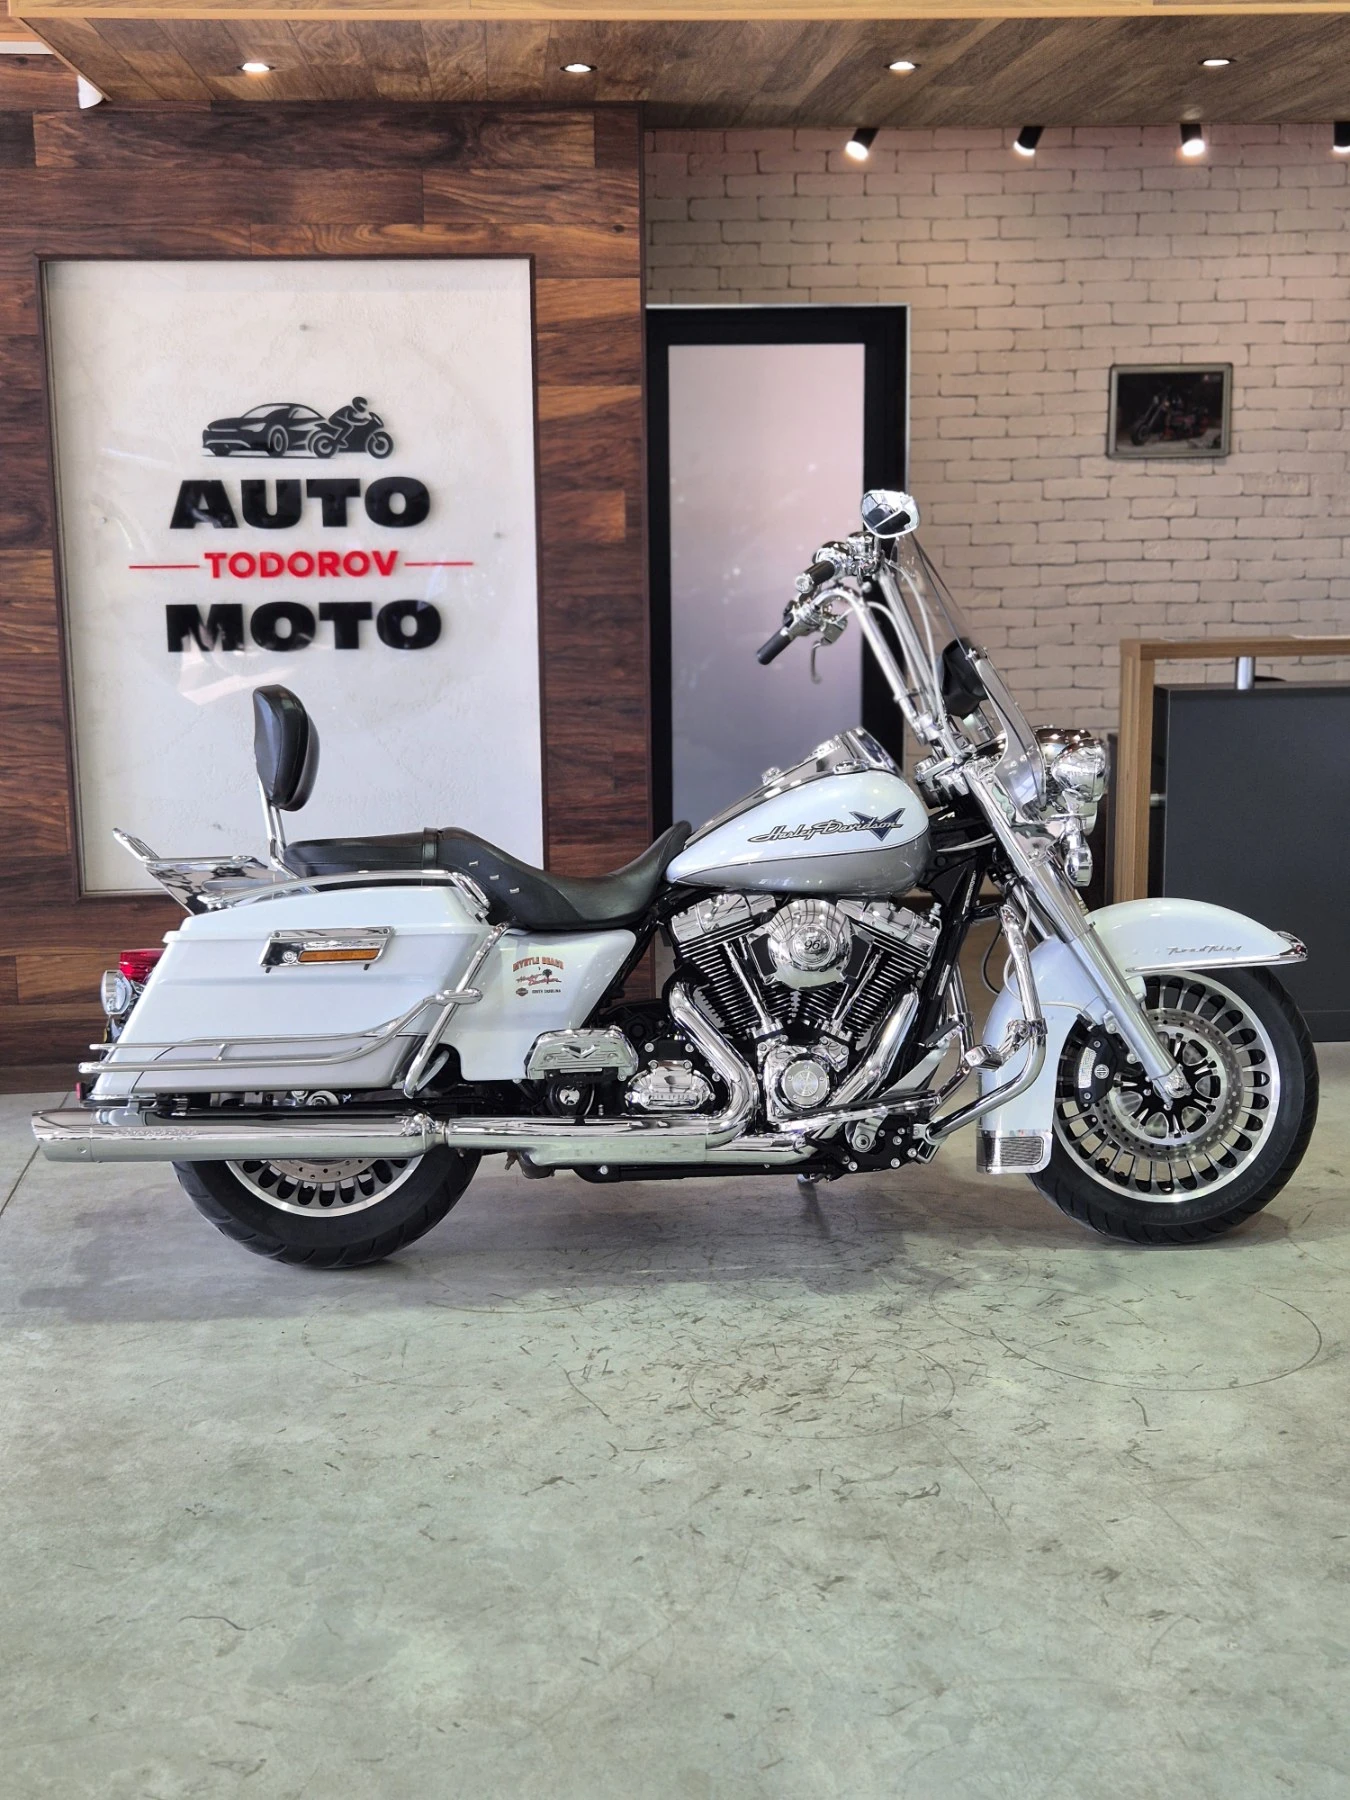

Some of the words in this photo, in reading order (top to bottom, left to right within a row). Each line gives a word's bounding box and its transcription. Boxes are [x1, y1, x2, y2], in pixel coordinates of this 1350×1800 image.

[169, 476, 431, 529] AUTO
[204, 550, 398, 579] TODOROV
[165, 600, 442, 652] MOTO
[747, 816, 904, 842] Harley-Davidson
[804, 939, 820, 950] 96
